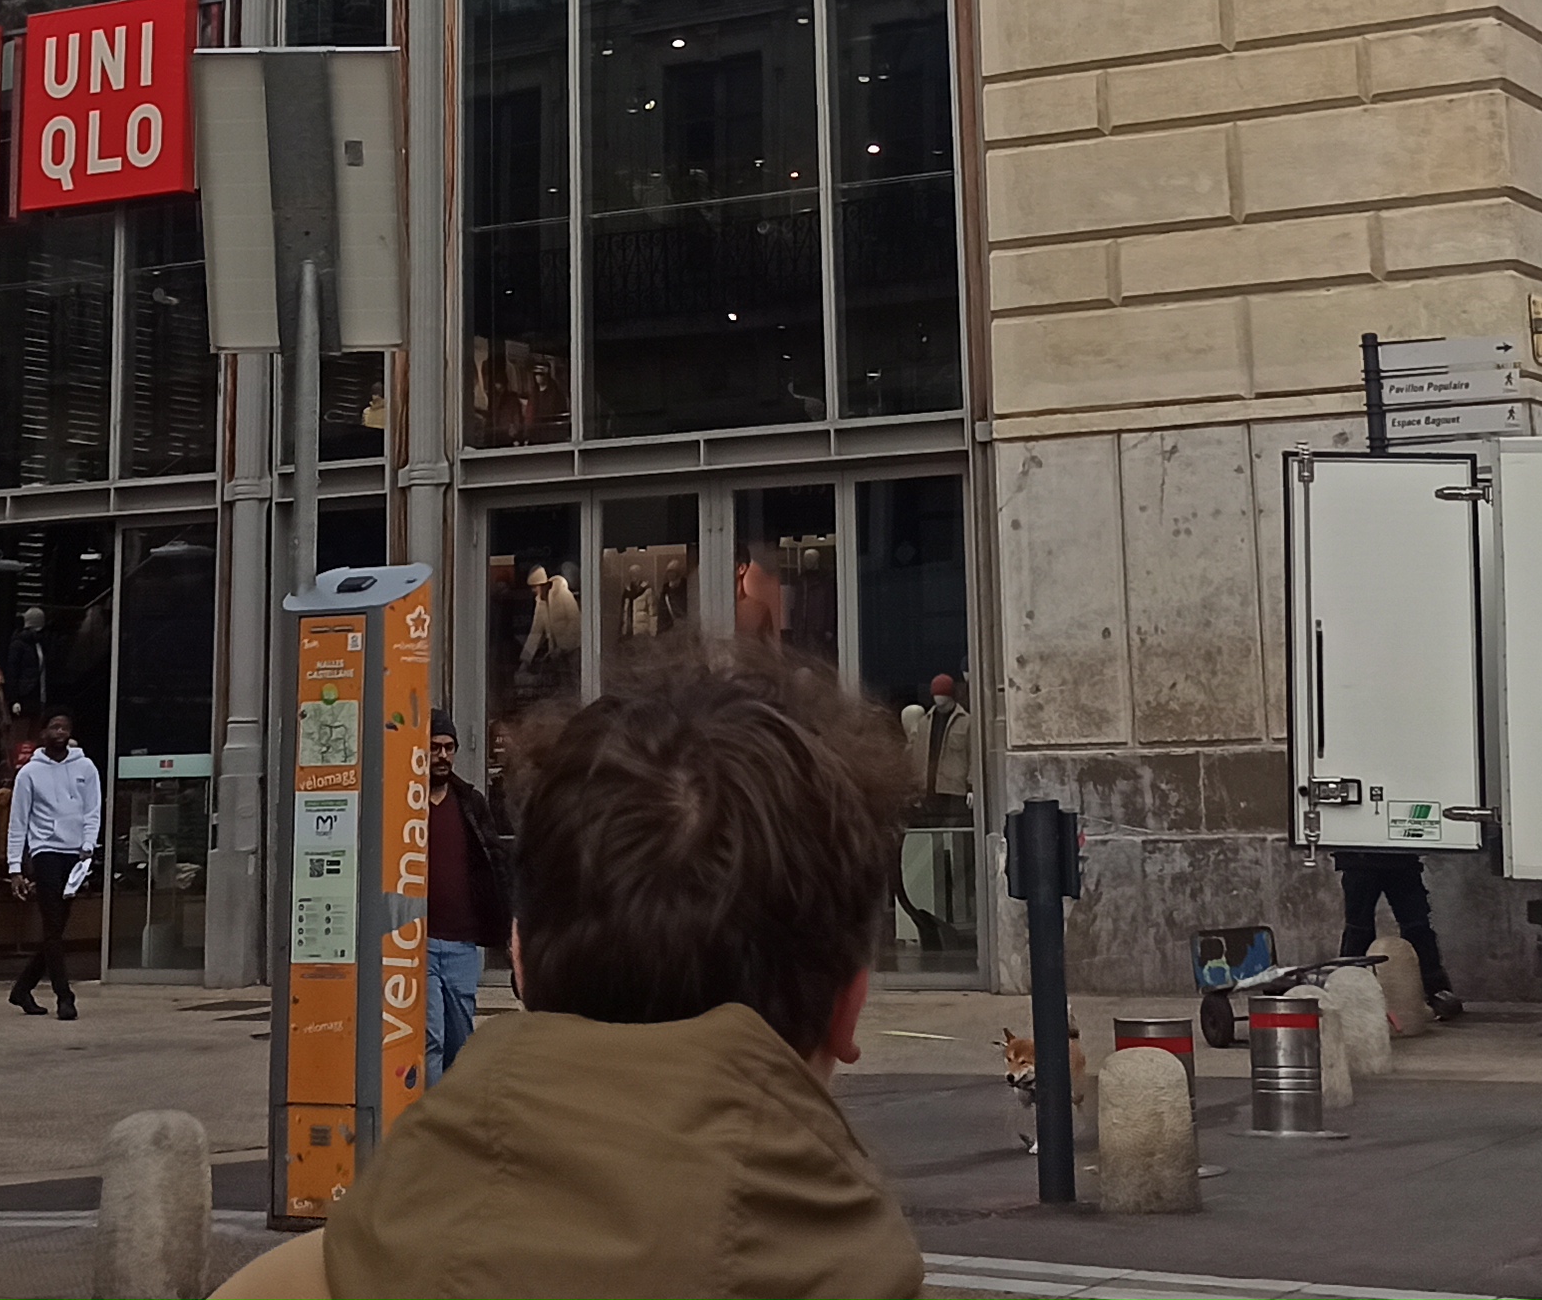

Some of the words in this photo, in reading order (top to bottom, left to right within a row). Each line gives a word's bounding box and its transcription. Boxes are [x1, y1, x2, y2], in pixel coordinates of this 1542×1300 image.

[43, 20, 155, 100] UNI
[40, 102, 163, 190] QLO
[1389, 383, 1425, 394] Pavillon
[1426, 380, 1470, 393] Populaire
[1391, 417, 1422, 429] Espace
[1424, 415, 1461, 428] Bagouet
[298, 769, 357, 792] vélomagg
